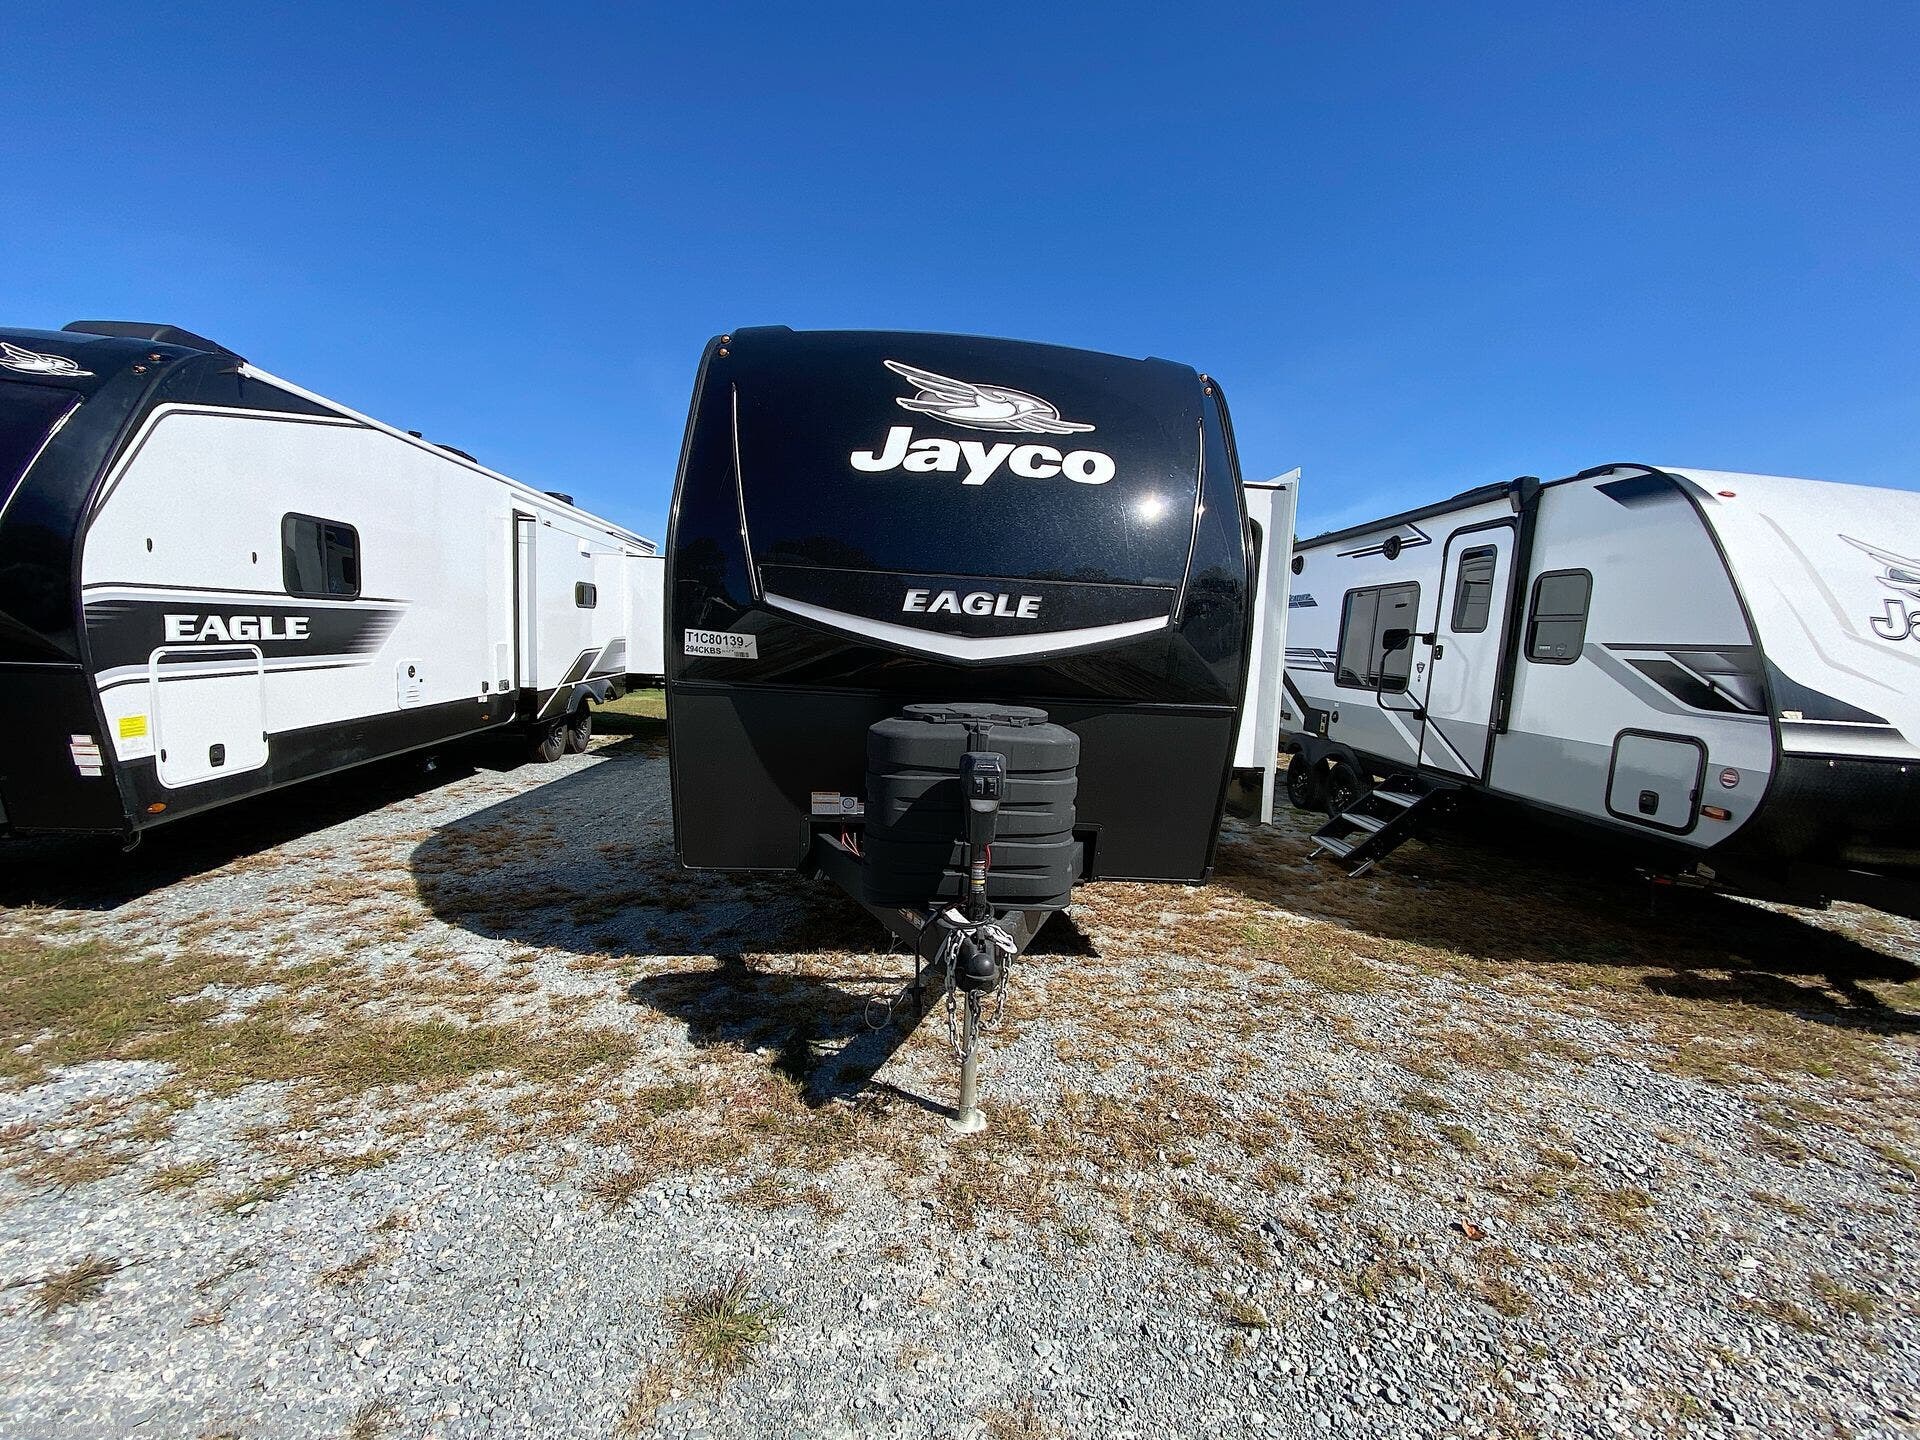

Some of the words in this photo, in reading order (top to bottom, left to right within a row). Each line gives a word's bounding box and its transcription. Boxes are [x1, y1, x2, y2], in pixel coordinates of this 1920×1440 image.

[850, 426, 1116, 485] Jayco
[902, 588, 1043, 619] EAGLE
[164, 614, 311, 642] EAGLE
[686, 631, 744, 647] T1C80139
[686, 645, 721, 655] 294CKBS
